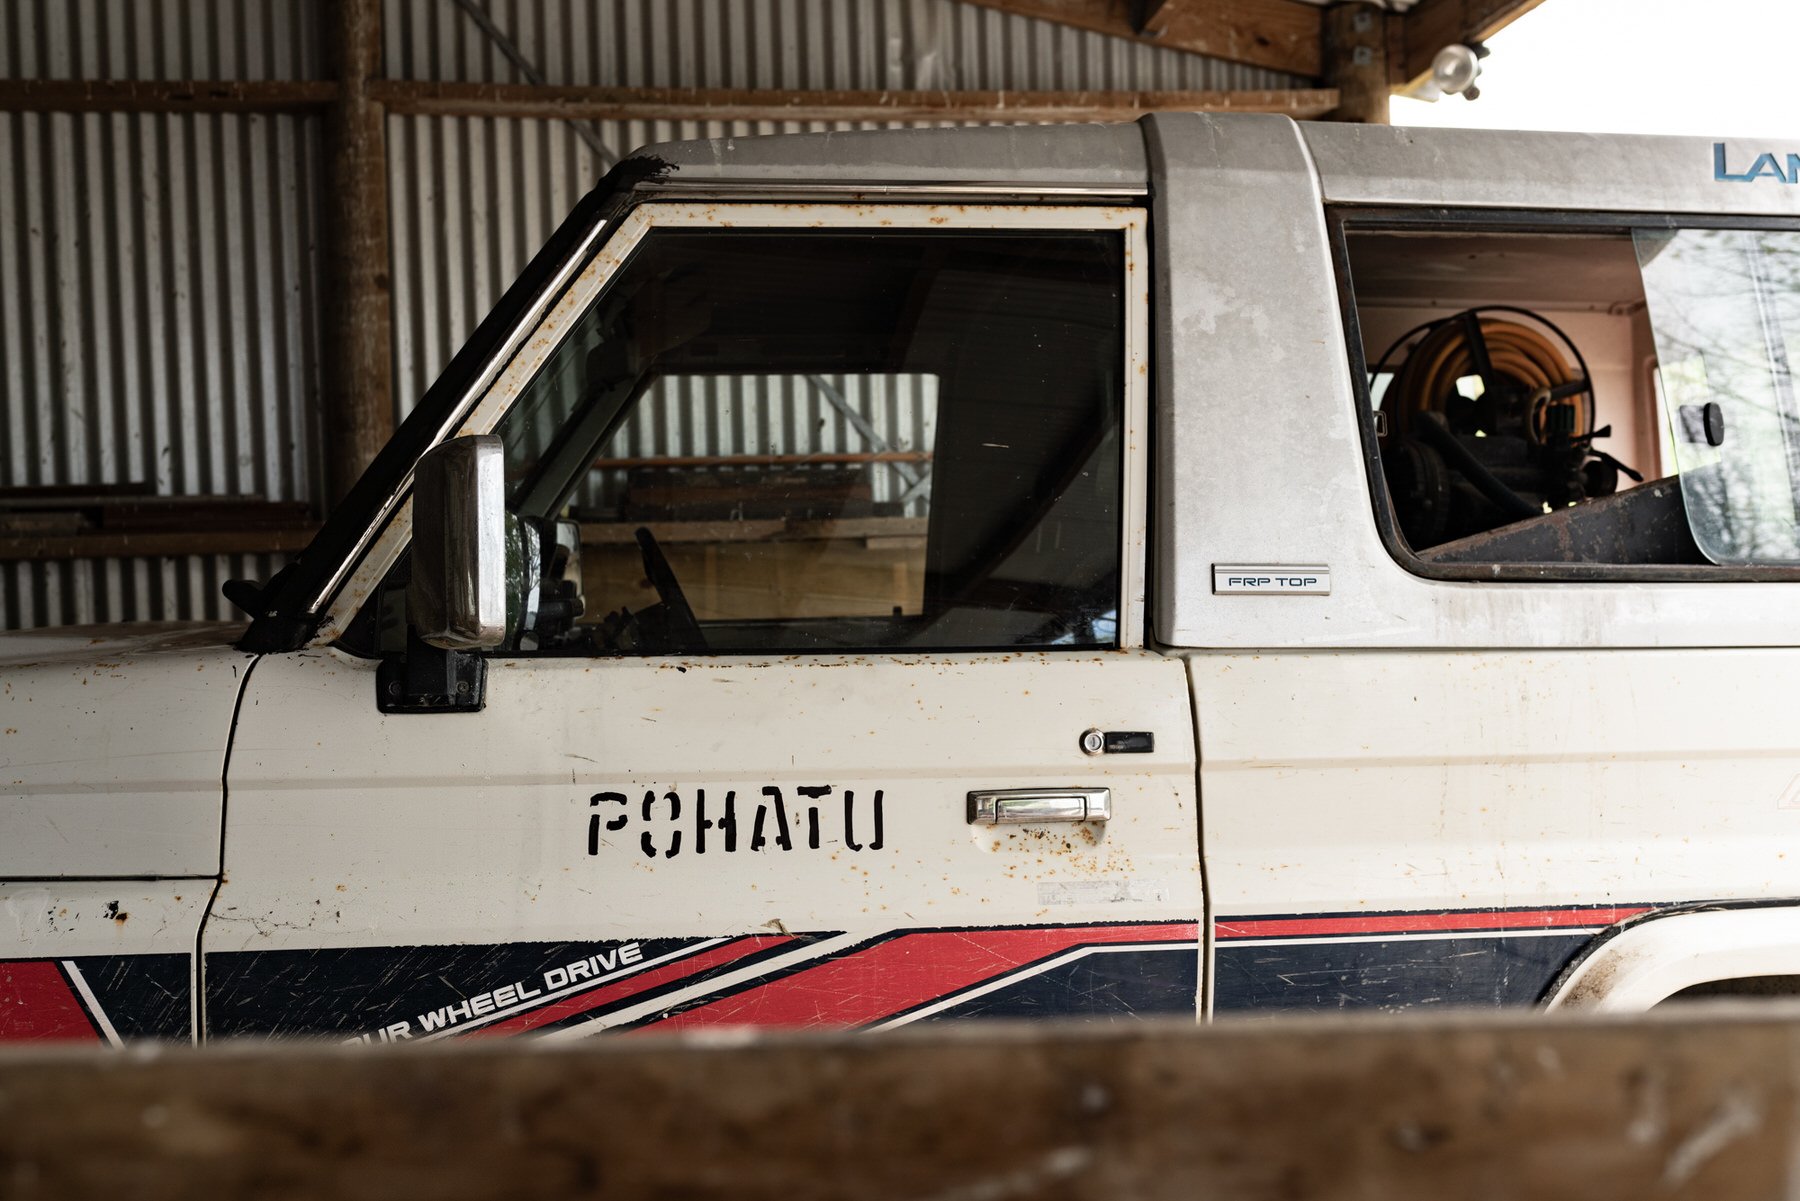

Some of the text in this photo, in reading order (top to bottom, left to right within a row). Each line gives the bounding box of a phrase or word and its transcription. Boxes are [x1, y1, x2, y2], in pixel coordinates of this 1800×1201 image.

[1228, 577, 1317, 587] FRP TOP
[588, 786, 884, 859] POHATU
[417, 981, 541, 1032] WHEEL
[544, 942, 644, 991] DRIVE
